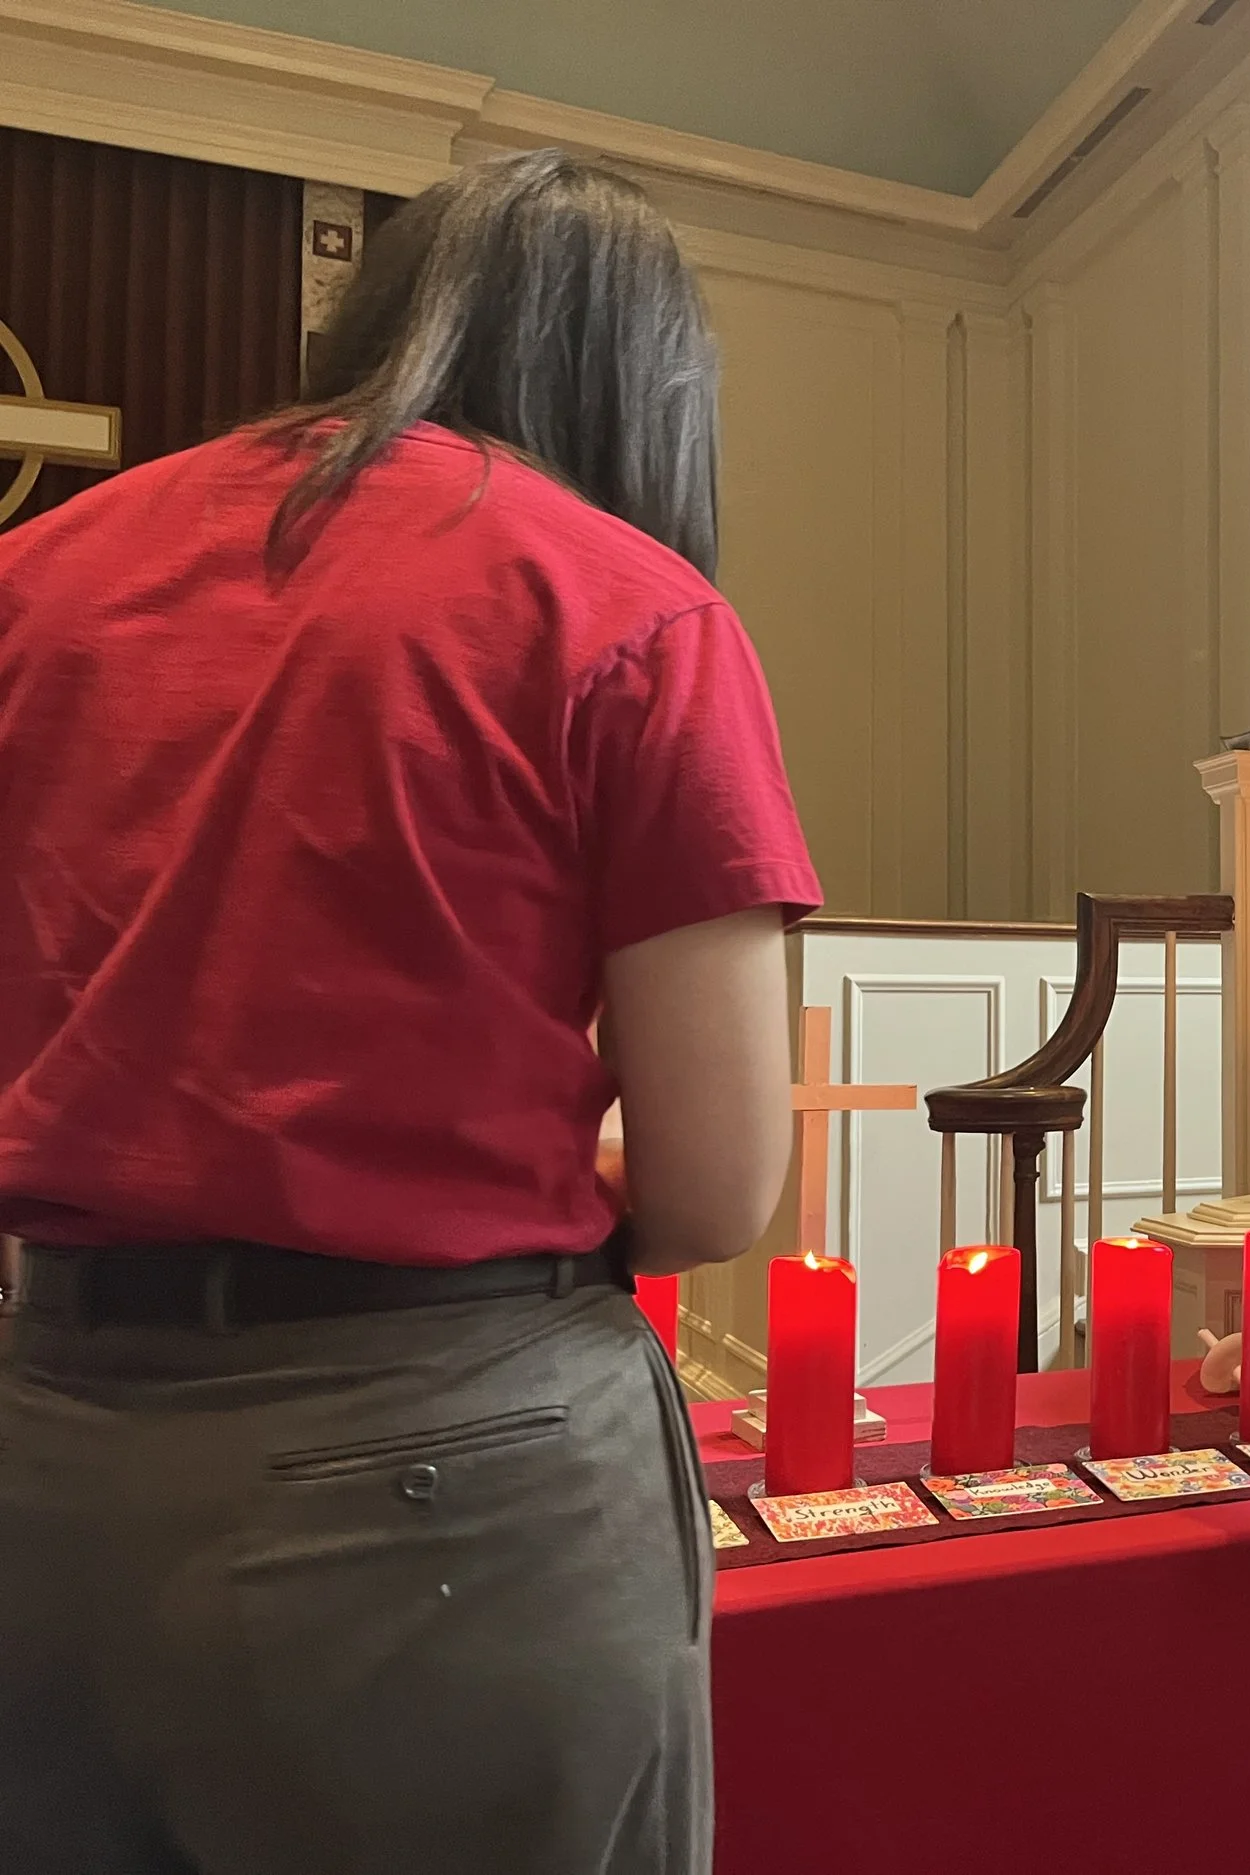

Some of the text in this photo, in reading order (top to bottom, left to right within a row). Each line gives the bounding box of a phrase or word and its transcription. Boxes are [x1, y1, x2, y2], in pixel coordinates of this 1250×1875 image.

[1125, 1464, 1209, 1480] Wonder
[969, 1481, 1051, 1496] Knowledge
[795, 1500, 897, 1525] Strength
